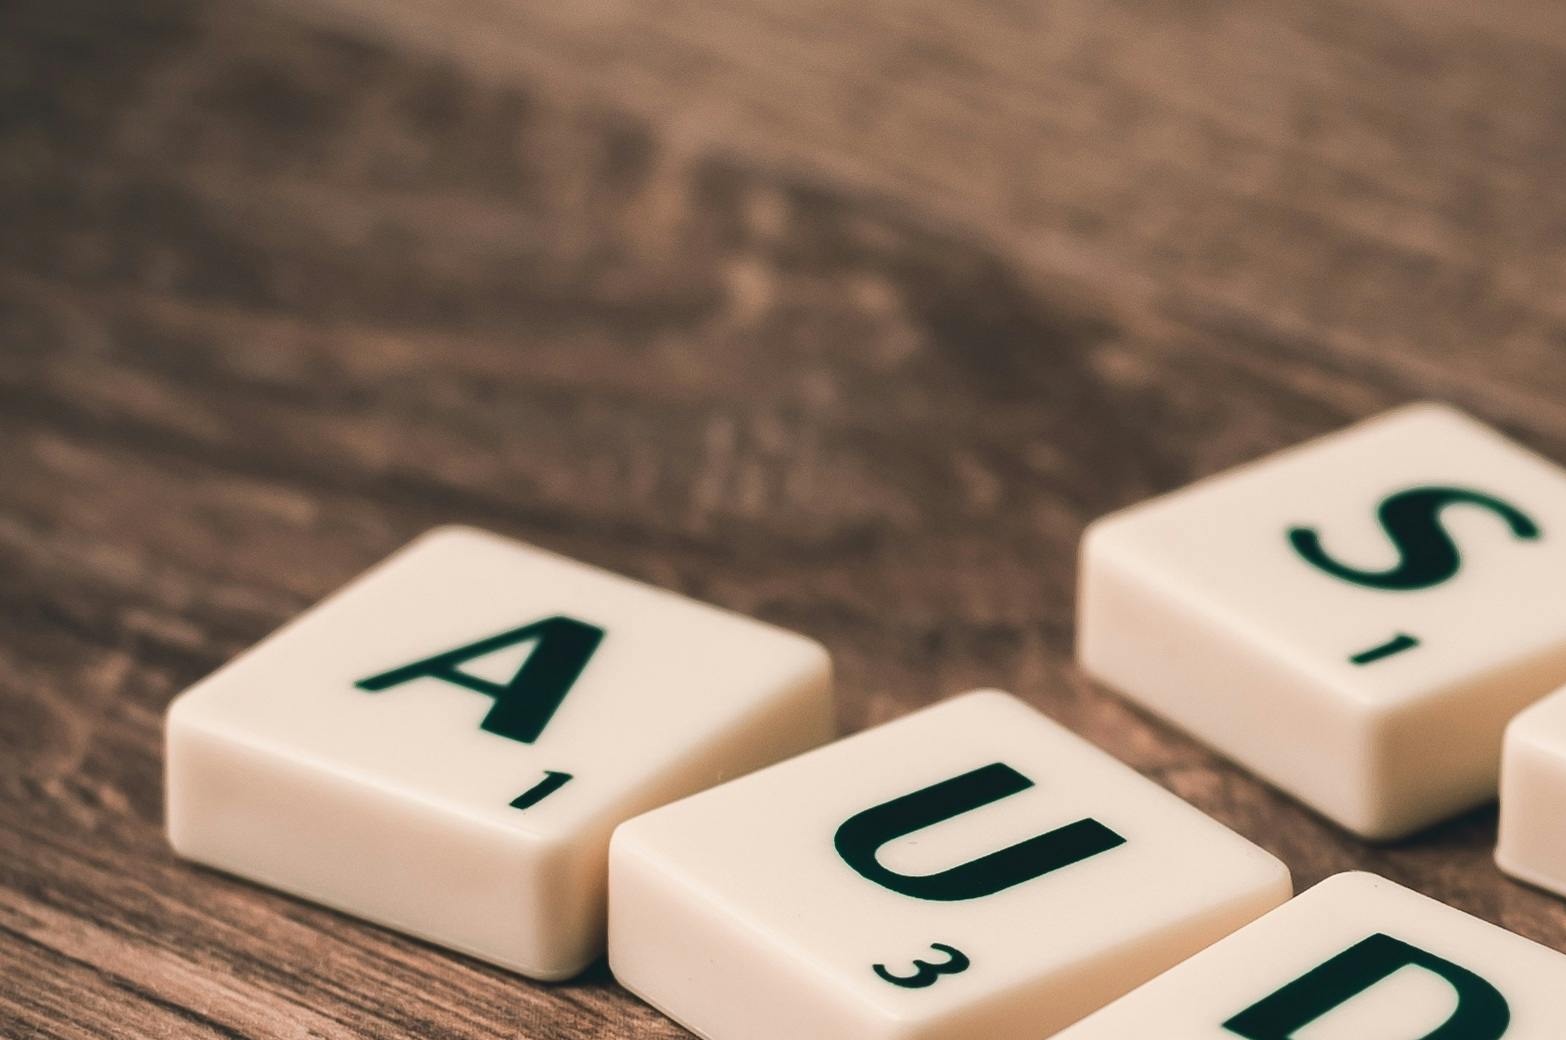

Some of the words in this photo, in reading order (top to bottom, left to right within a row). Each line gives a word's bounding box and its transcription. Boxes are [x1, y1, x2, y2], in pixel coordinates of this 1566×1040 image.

[1287, 485, 1540, 592] S
[353, 615, 606, 745] A
[1350, 633, 1419, 666] 1
[508, 769, 574, 811] 1
[833, 761, 1128, 903] U
[871, 941, 971, 990] 3
